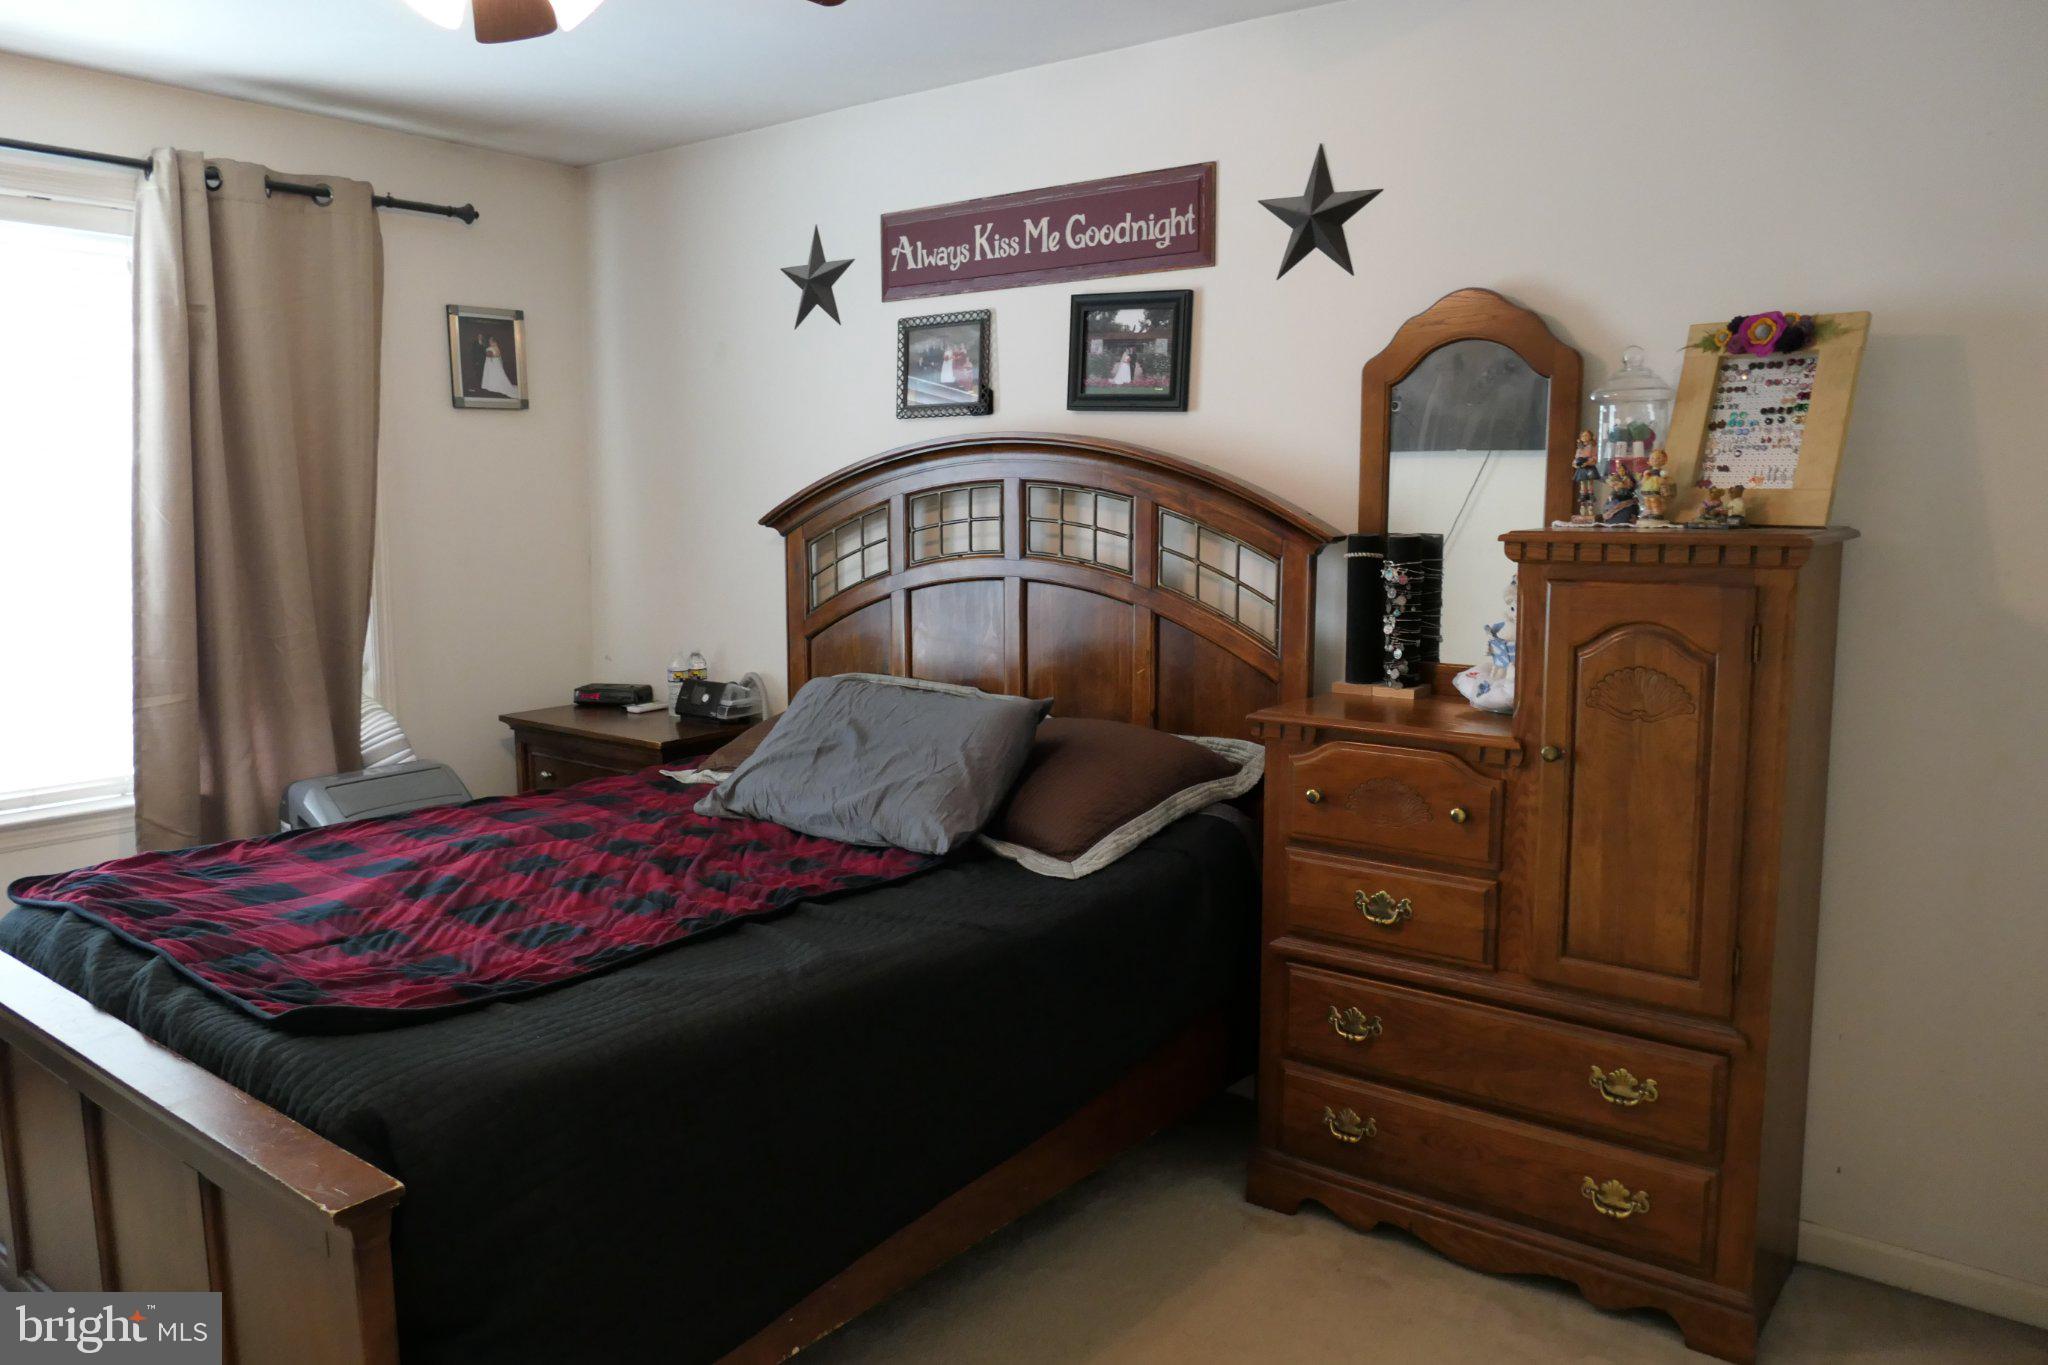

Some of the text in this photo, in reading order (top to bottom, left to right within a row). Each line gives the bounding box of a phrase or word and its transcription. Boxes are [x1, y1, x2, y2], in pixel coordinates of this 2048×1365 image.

[891, 204, 1196, 271] Always Kiss Me Goodnight
